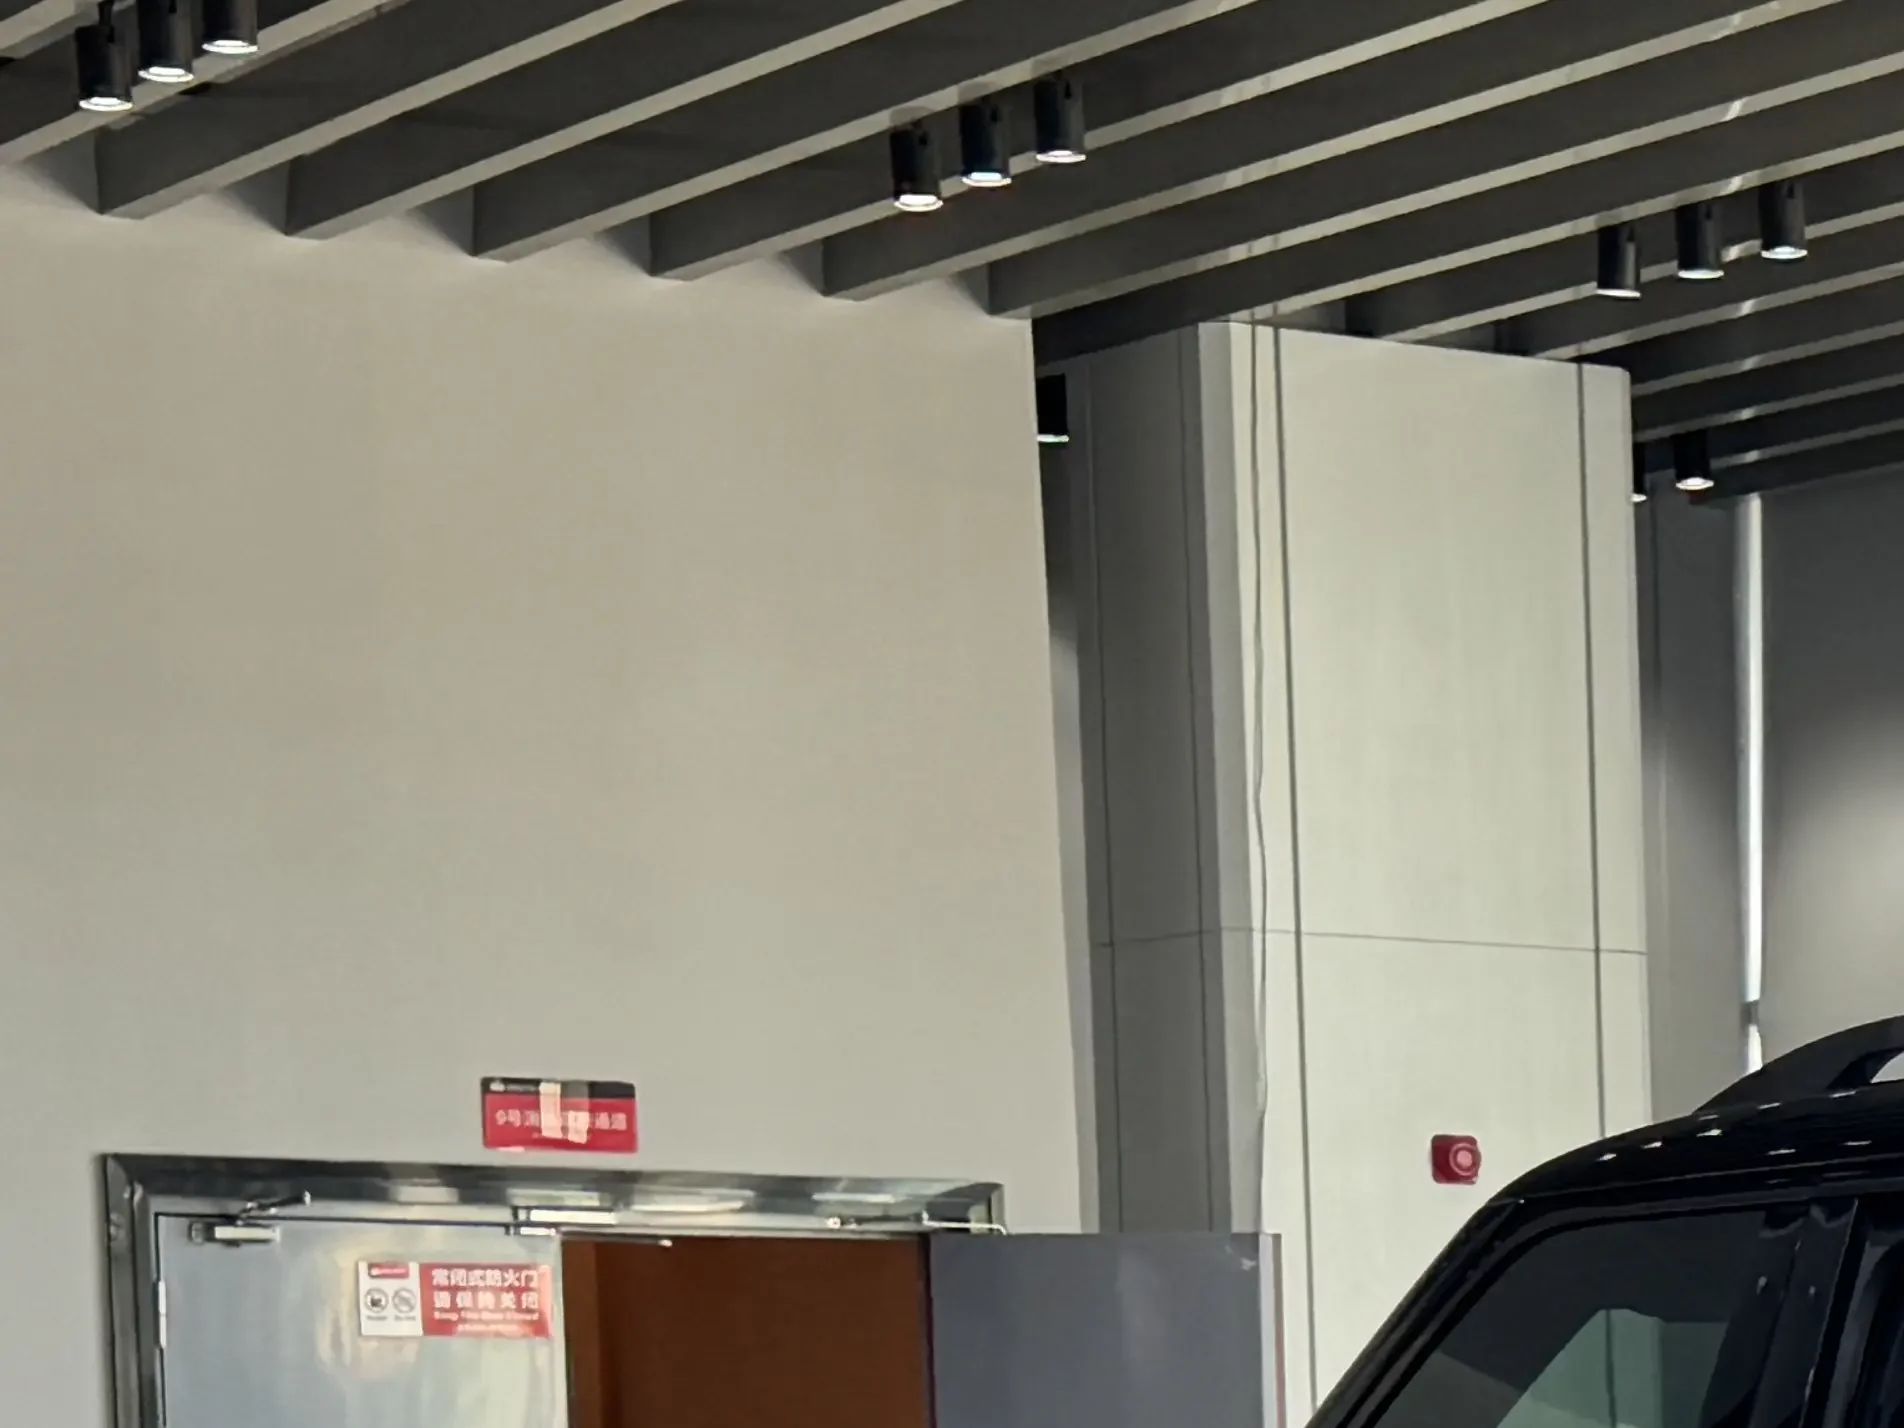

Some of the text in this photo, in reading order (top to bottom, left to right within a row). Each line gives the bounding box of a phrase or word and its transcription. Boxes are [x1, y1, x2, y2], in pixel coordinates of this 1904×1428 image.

[432, 1268, 538, 1287] 常闭式防火门
